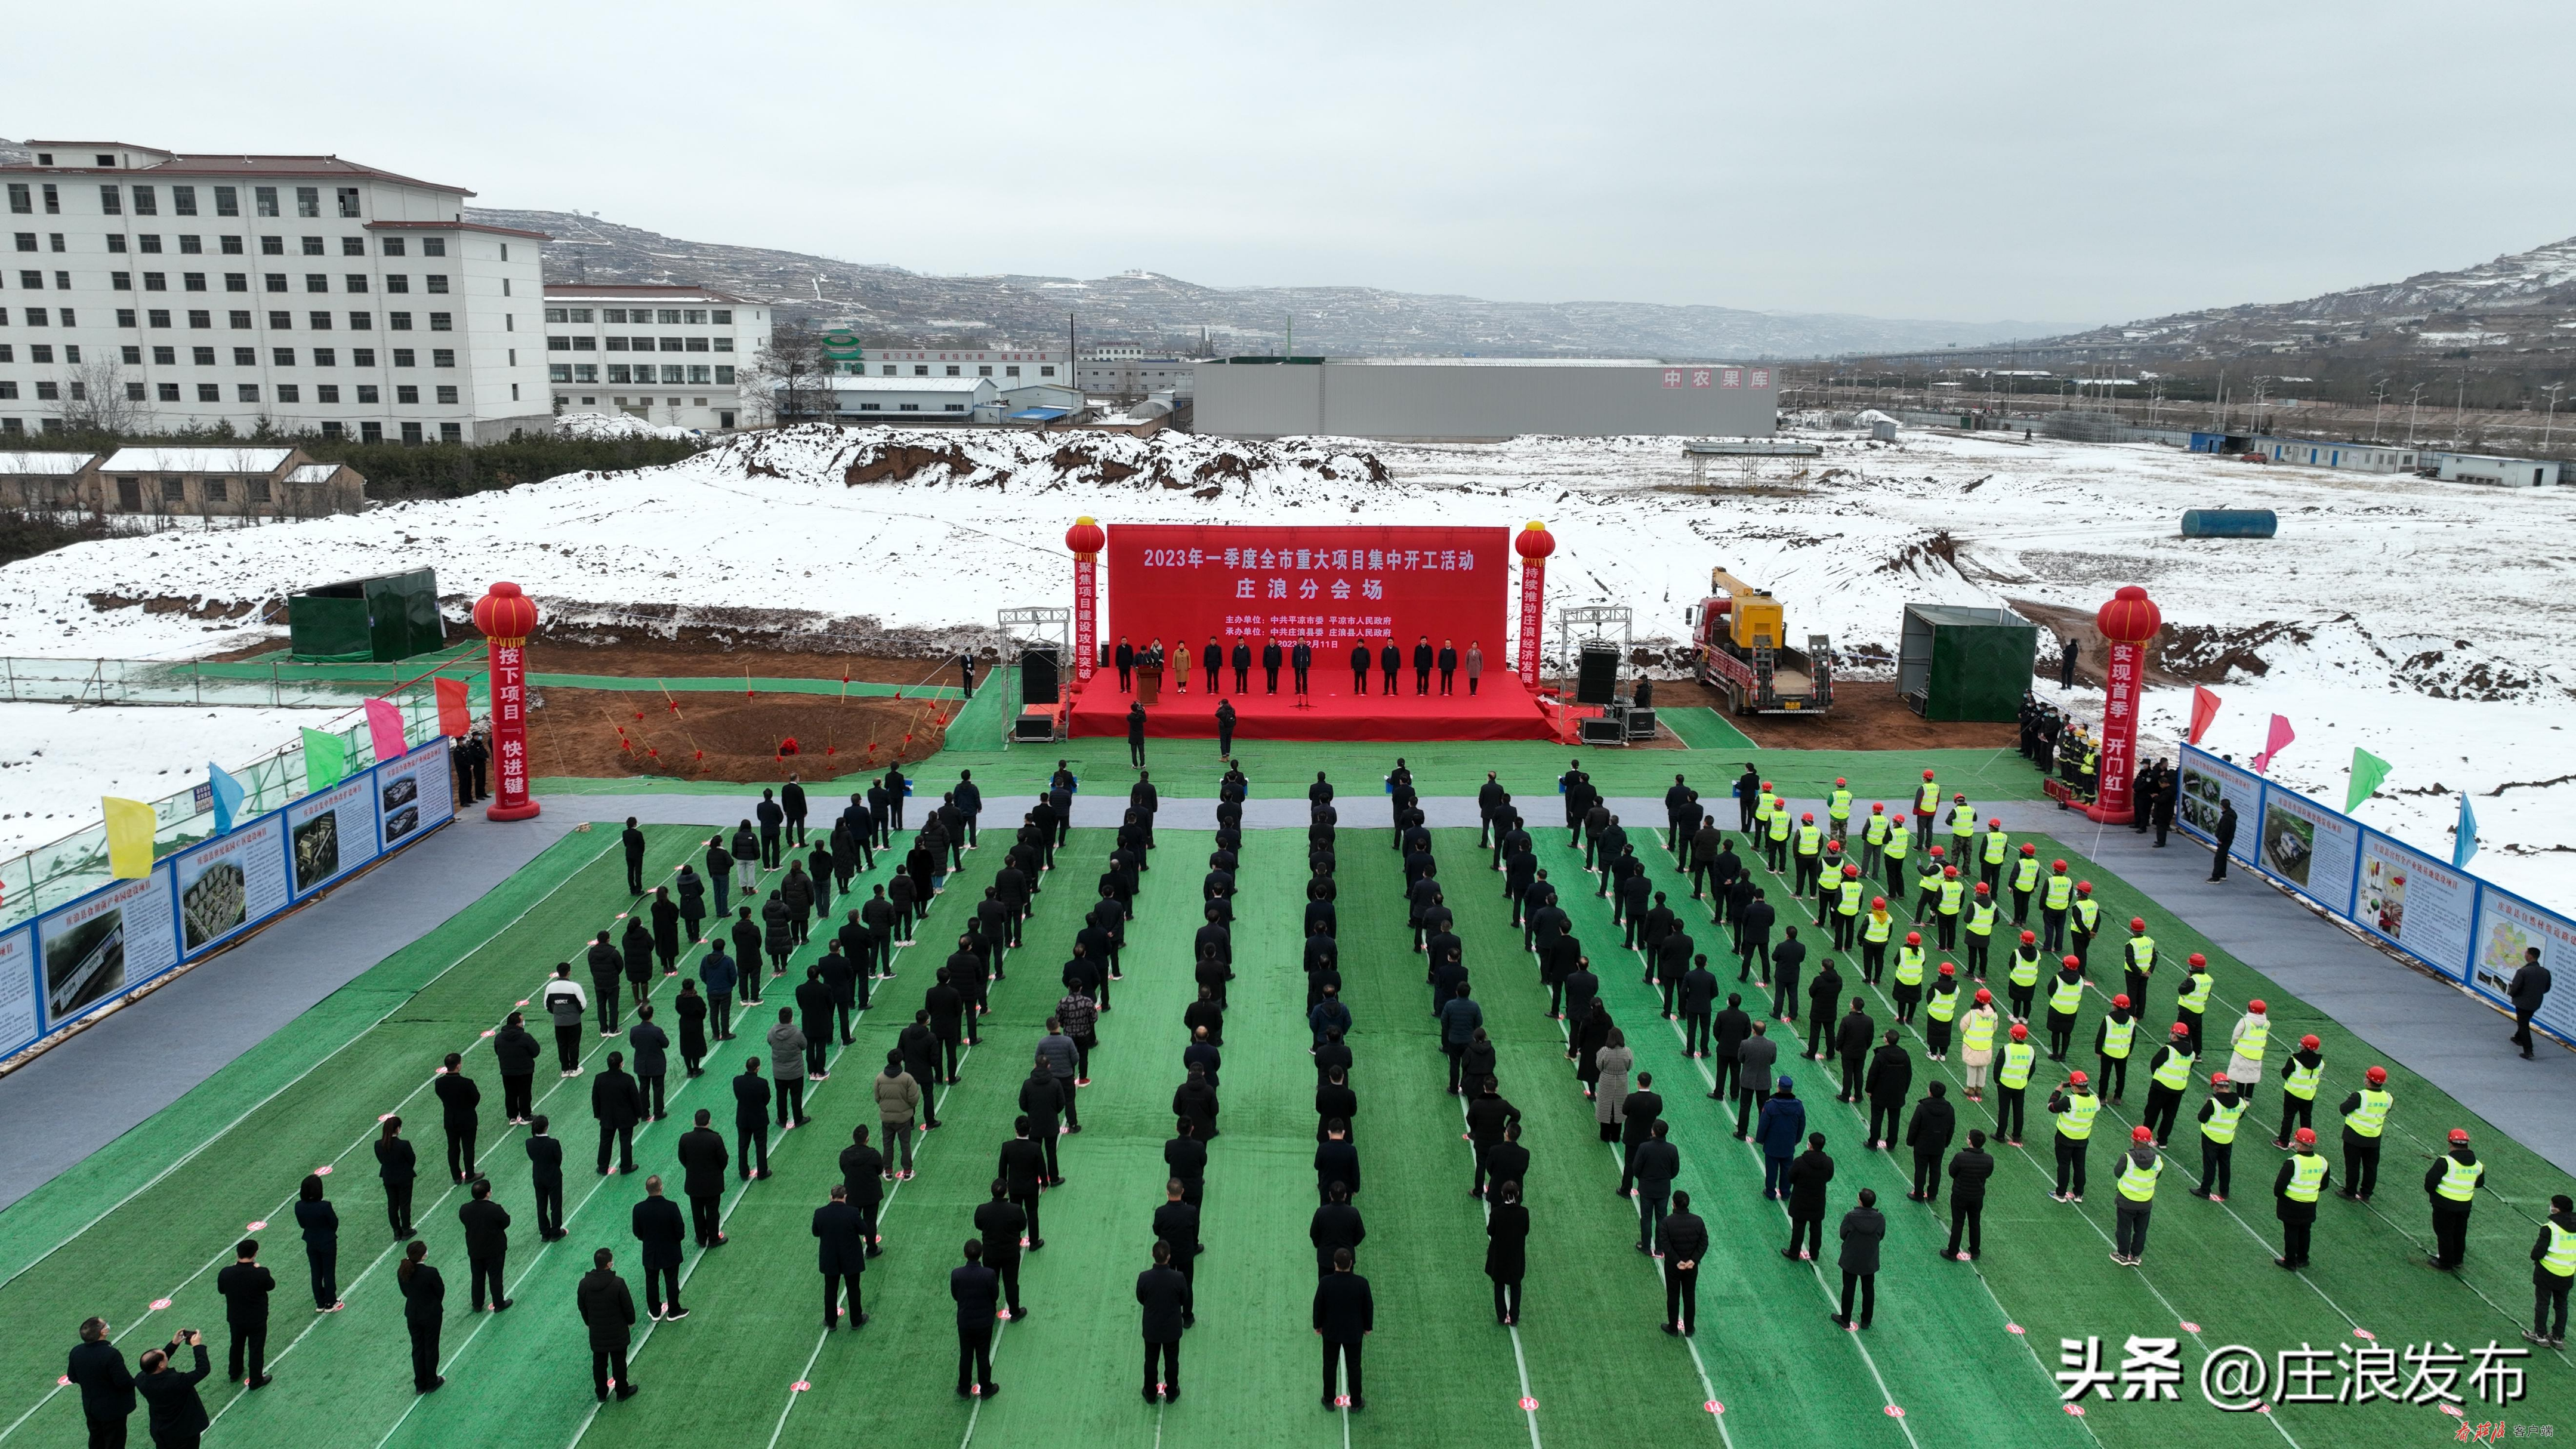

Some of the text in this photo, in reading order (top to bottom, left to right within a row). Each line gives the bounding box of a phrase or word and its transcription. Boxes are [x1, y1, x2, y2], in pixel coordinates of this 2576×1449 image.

[1664, 369, 1769, 389] 中农果库
[1144, 547, 1474, 571] 2023年一季度全市重大项目集中开工活动
[1235, 578, 1383, 600] 庄浪分会场
[1078, 562, 1092, 679] 聚焦项目建设攻坚突破
[1329, 616, 1392, 625] 平凉市人民政府
[1521, 568, 1539, 684] 持续推动庄浪经济发展
[1329, 628, 1392, 637] 庄浪县人民政府
